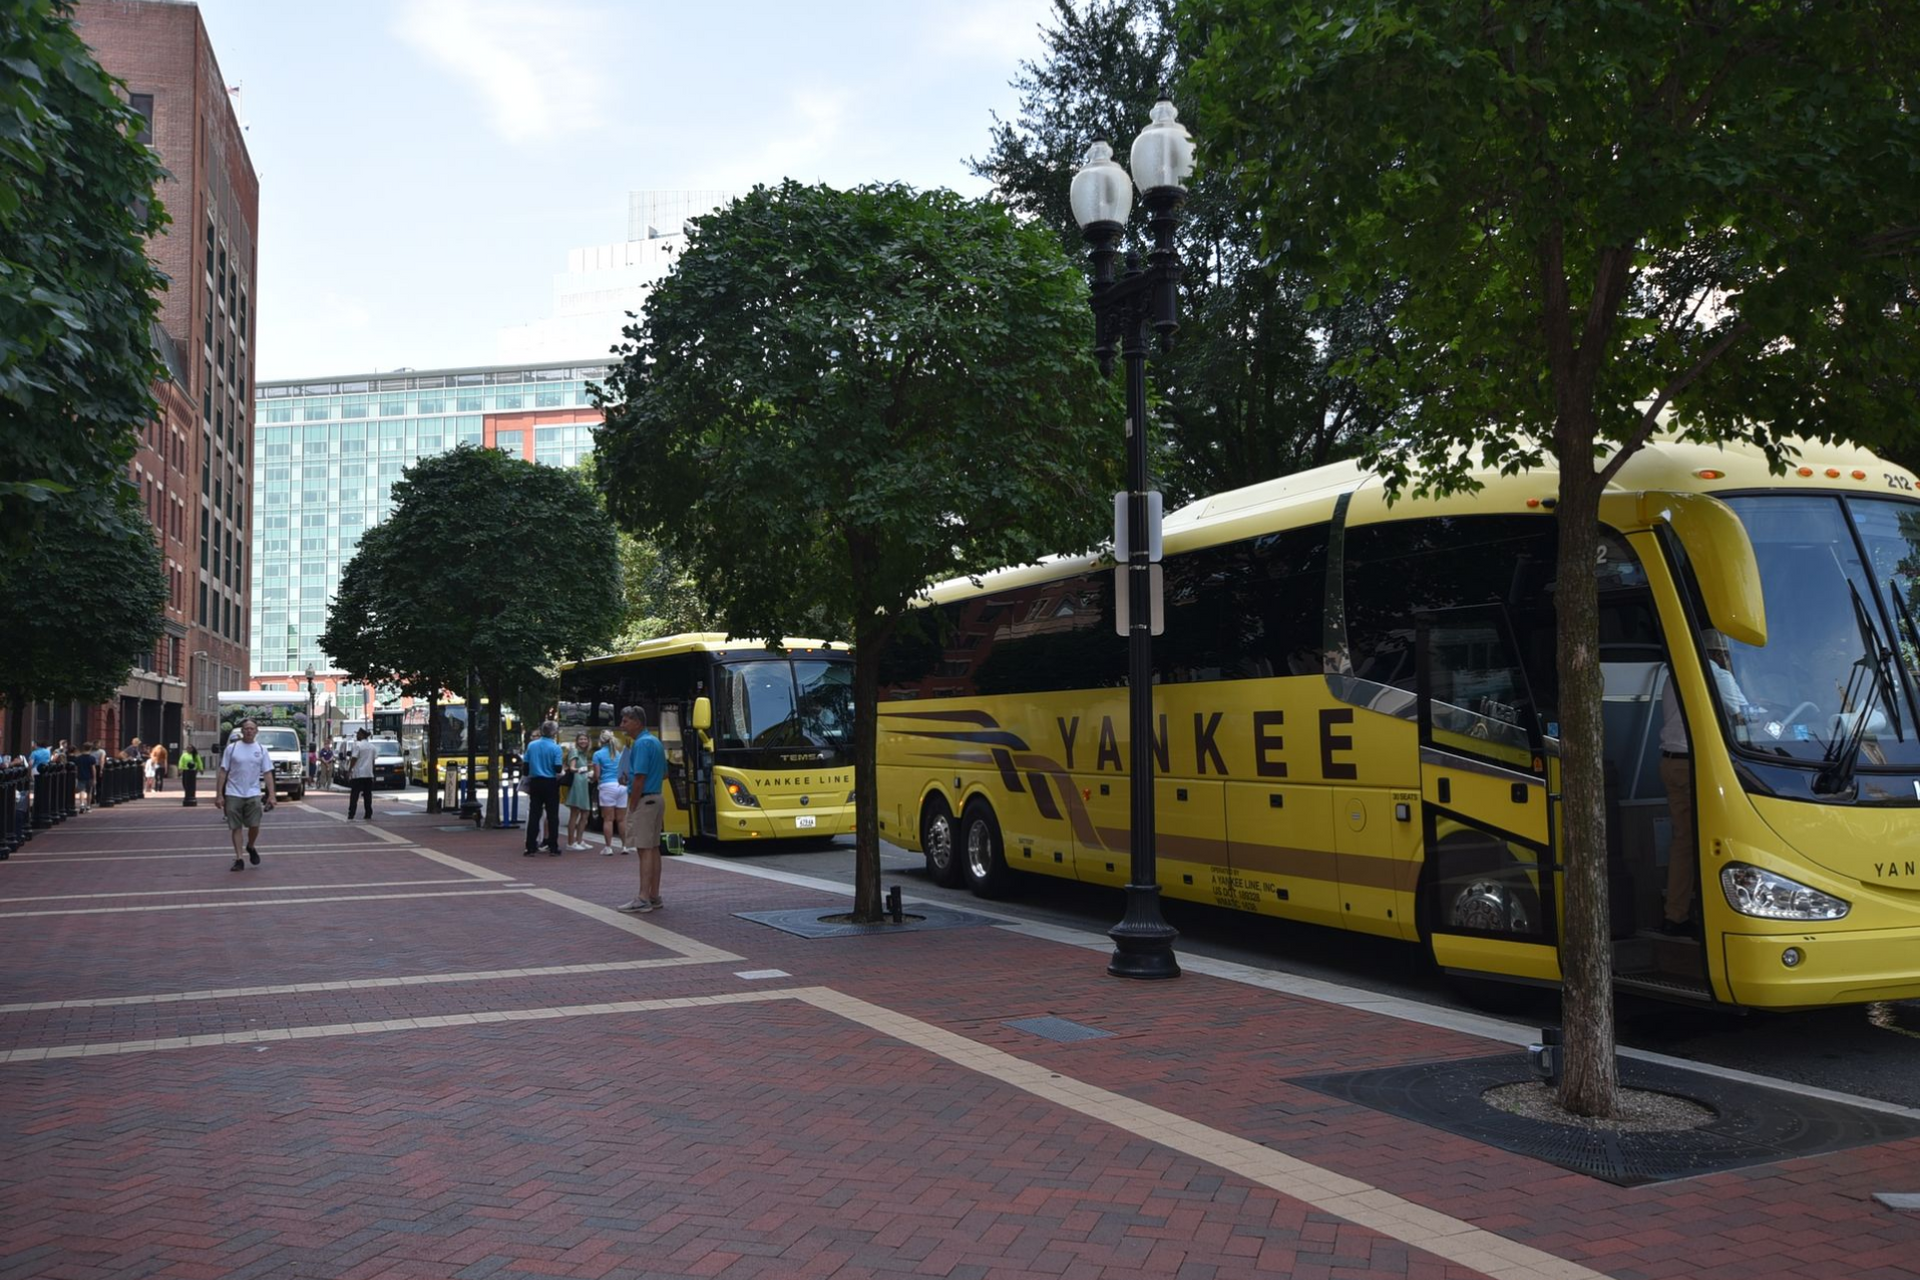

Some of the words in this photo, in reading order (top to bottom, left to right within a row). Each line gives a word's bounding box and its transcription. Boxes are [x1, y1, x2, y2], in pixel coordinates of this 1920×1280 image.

[1883, 473, 1912, 490] 212
[1057, 708, 1358, 780] YANKEE
[780, 753, 825, 761] TEMSA
[755, 776, 810, 787] YANKEE
[819, 775, 850, 784] LINE
[1874, 861, 1915, 878] YAN
[1212, 875, 1217, 884] A
[1218, 876, 1243, 888] YANKEE
[1212, 886, 1222, 896] US
